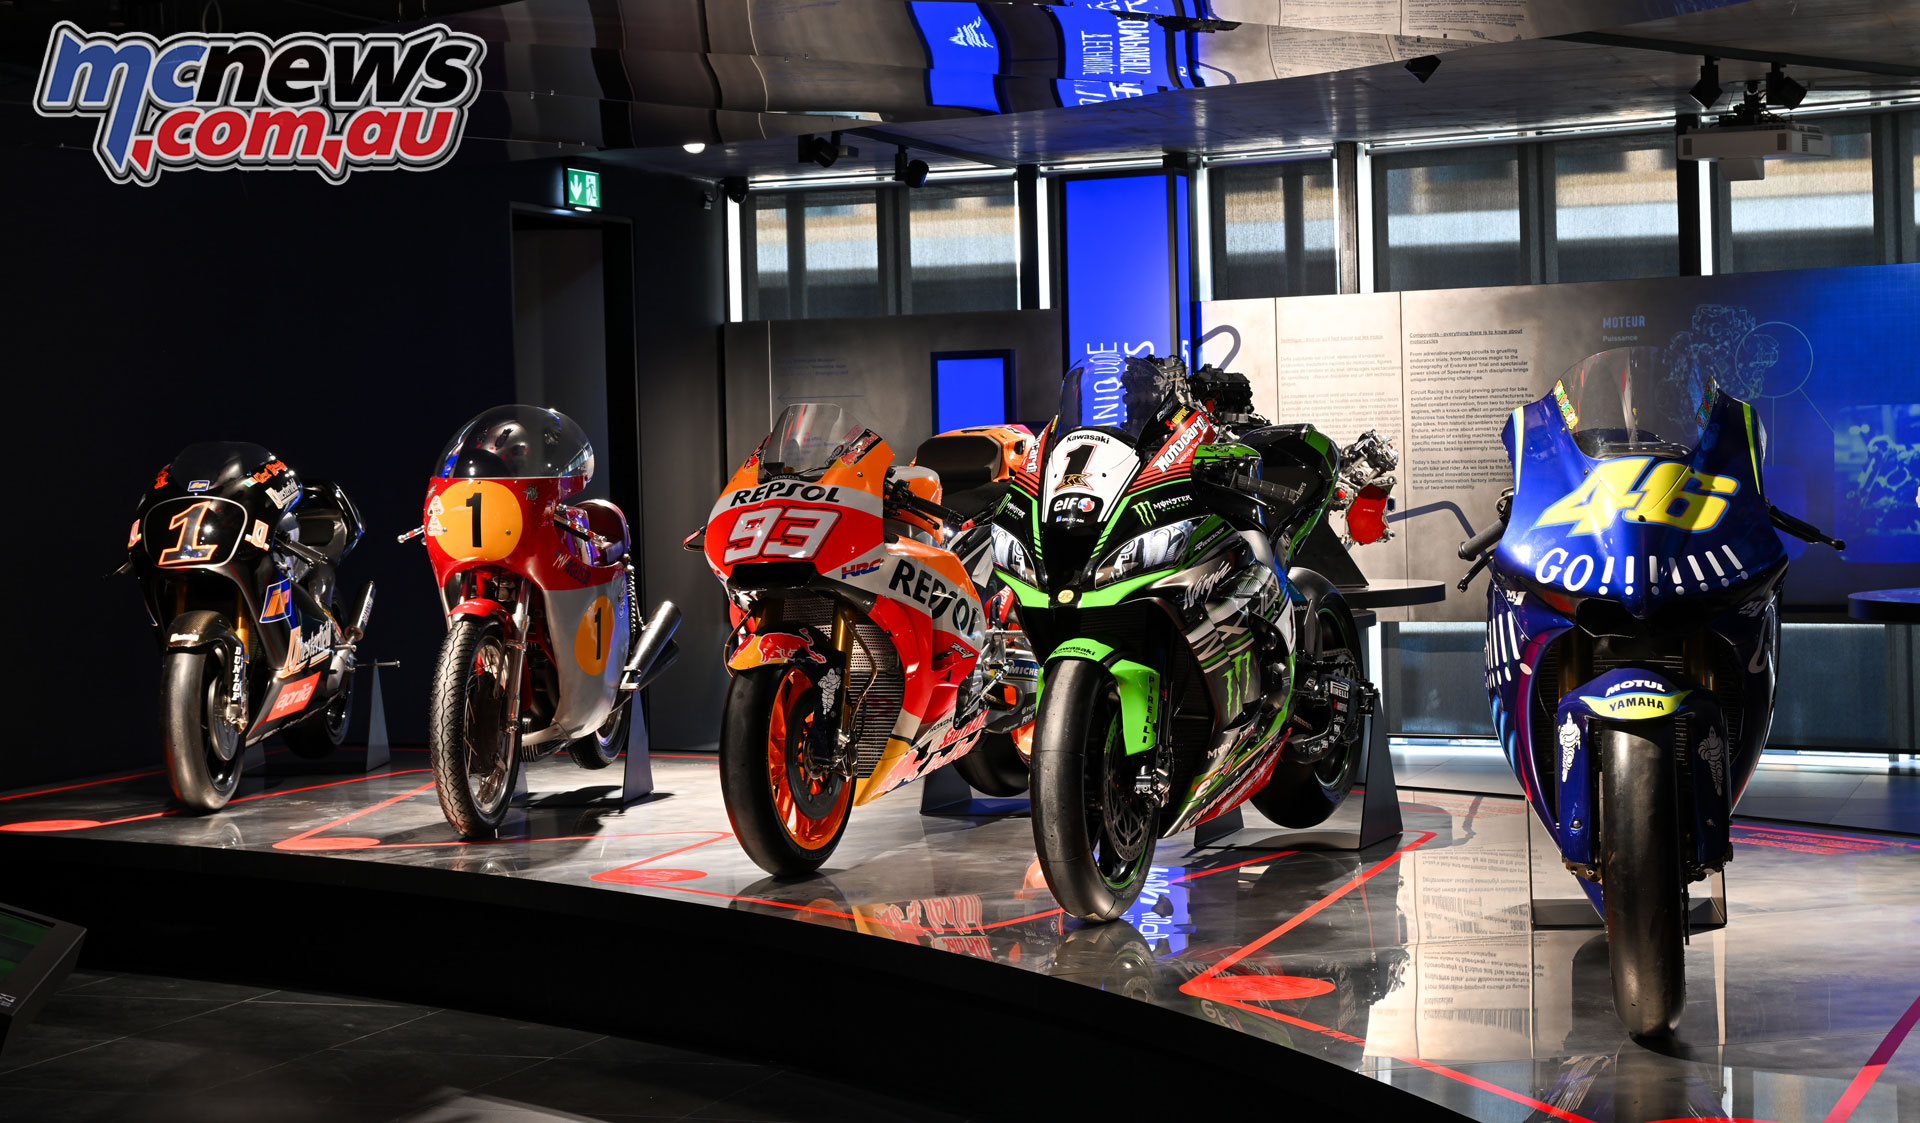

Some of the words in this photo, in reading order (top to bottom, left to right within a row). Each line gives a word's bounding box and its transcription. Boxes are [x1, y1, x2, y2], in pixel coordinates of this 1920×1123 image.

[1602, 315, 1646, 329] MOTEUR
[1066, 434, 1110, 444] Kawasaki
[730, 481, 840, 508] REPSOL
[1054, 497, 1079, 512] elf
[1530, 455, 1741, 538] 46
[159, 500, 218, 566] 1
[466, 492, 482, 548] 1
[723, 505, 842, 566] 93
[841, 558, 884, 580] HRC
[594, 607, 602, 660] 1
[232, 646, 243, 701] DUNLOP
[276, 682, 314, 711] aprilia
[1605, 680, 1667, 698] MOTUL
[1142, 675, 1155, 744] PIRELLI
[1610, 697, 1664, 712] YAMAHA
